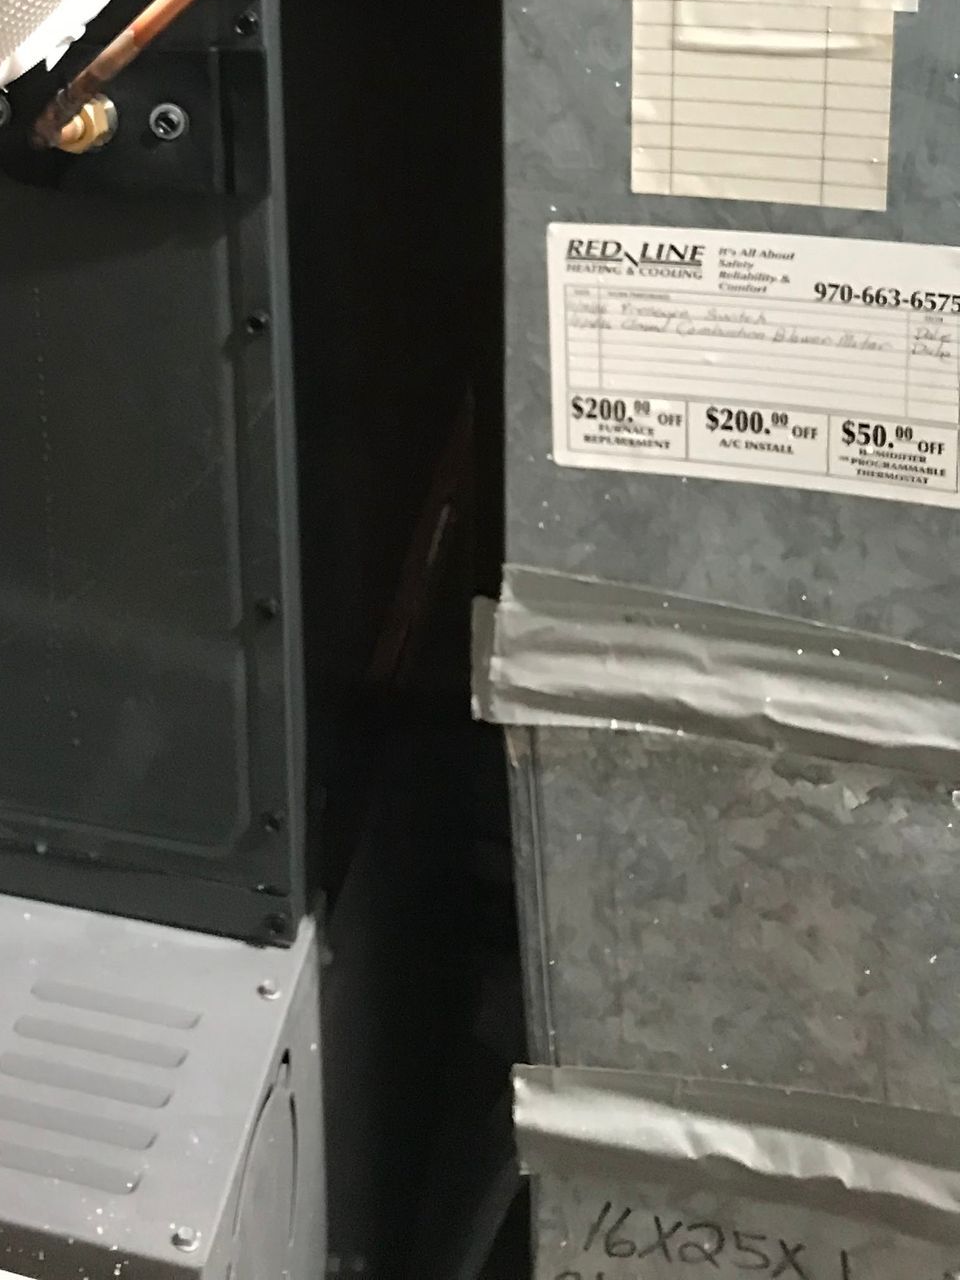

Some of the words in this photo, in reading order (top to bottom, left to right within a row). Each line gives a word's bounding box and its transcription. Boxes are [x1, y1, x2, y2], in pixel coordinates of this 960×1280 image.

[566, 238, 623, 260] RED
[640, 241, 707, 264] LINE
[740, 247, 757, 258] All
[759, 249, 795, 261] About
[566, 262, 622, 276] HEATING
[626, 267, 635, 276] &
[640, 267, 703, 280] COOLING
[813, 281, 960, 314] 970-663-6575
[657, 412, 683, 427] OFF
[792, 424, 819, 440] OFF
[719, 438, 740, 450] A/C
[744, 440, 795, 455] INSTALL
[917, 439, 946, 456] OFF
